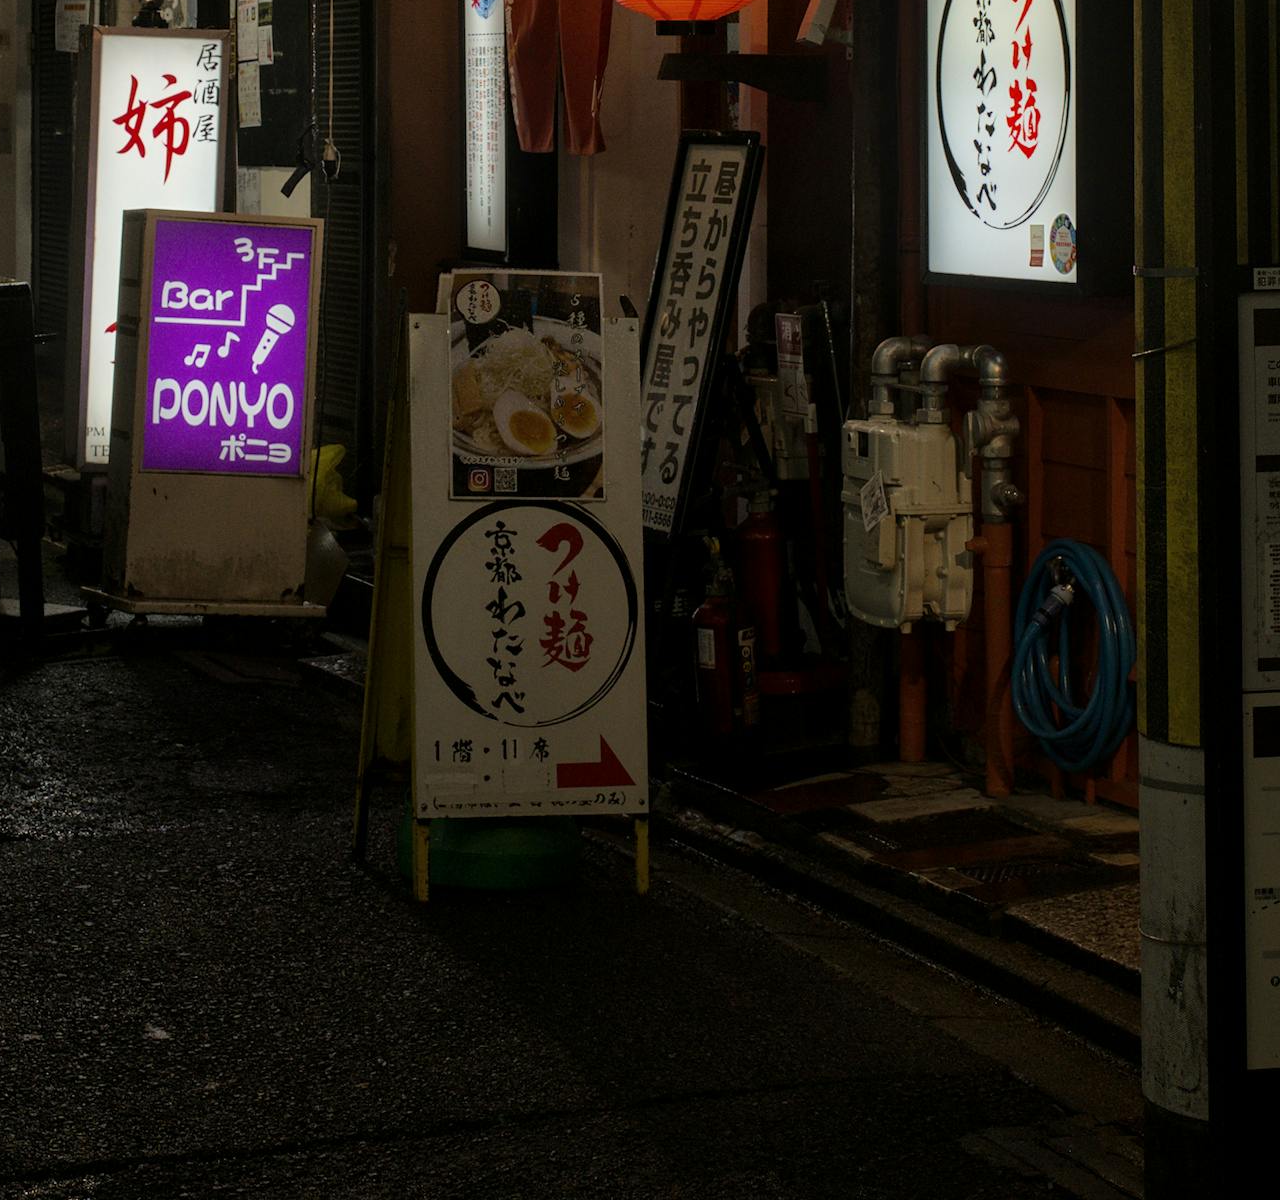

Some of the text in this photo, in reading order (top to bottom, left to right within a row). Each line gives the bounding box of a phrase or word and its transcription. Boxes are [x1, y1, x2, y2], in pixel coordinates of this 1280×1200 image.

[192, 42, 222, 143] 居酒屋
[161, 280, 234, 311] Bar
[233, 237, 280, 270] 3F
[659, 160, 740, 486] 昼からやってる
[152, 377, 295, 430] PONYO
[484, 520, 526, 714] 京都わたなべ
[535, 522, 595, 673] つけ麺
